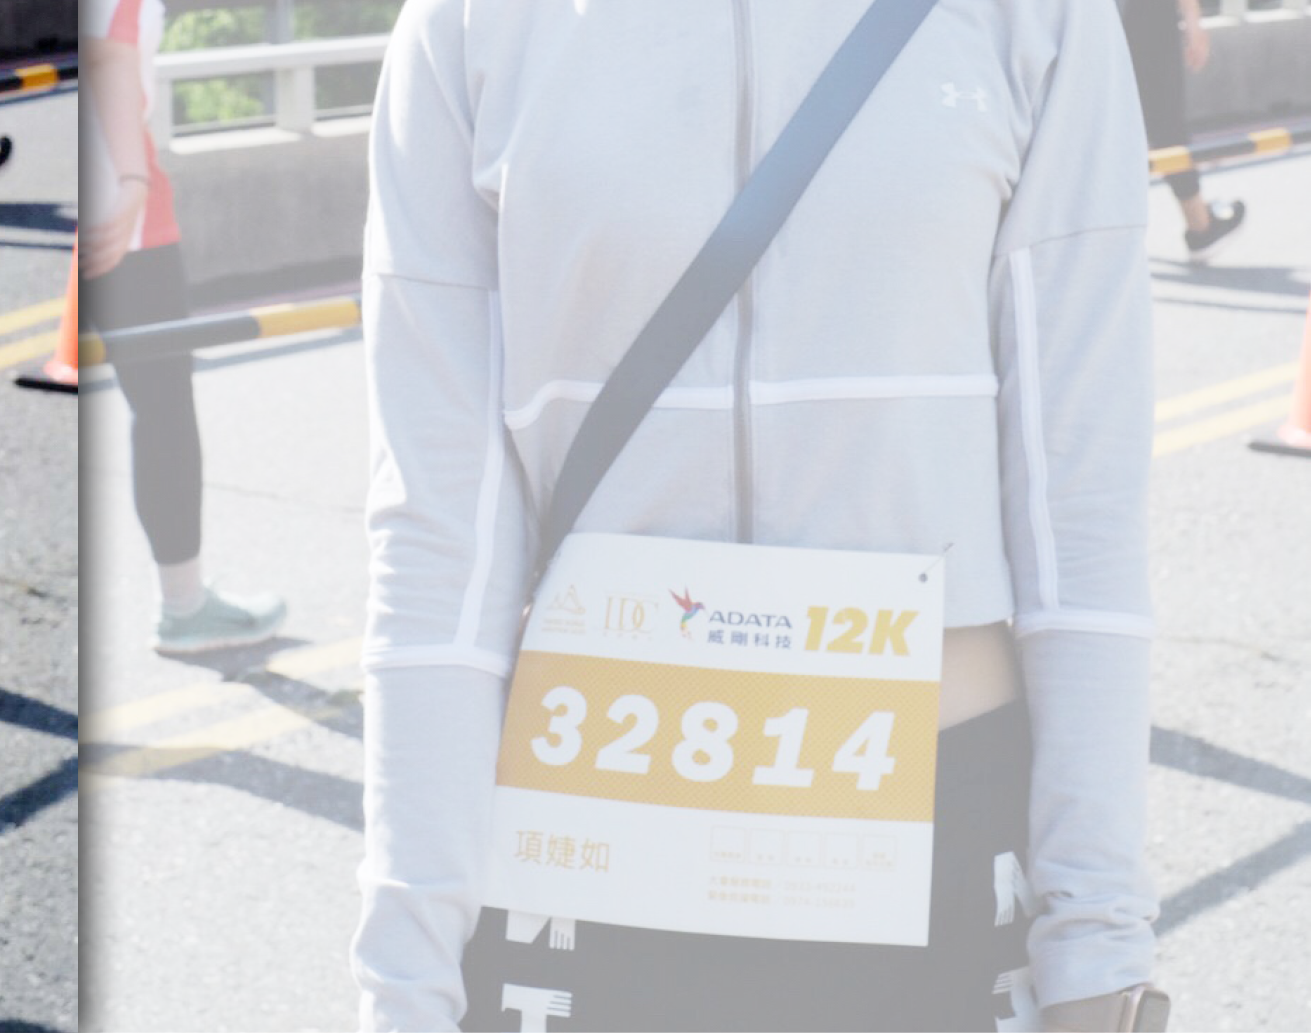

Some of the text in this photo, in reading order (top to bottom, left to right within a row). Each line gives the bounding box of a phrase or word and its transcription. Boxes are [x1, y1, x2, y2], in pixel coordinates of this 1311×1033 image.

[707, 629, 791, 649] 威剛科技
[708, 610, 793, 630] ADATA
[803, 605, 919, 657] 12K
[530, 685, 895, 791] 32814
[513, 829, 610, 873] 項婕如
